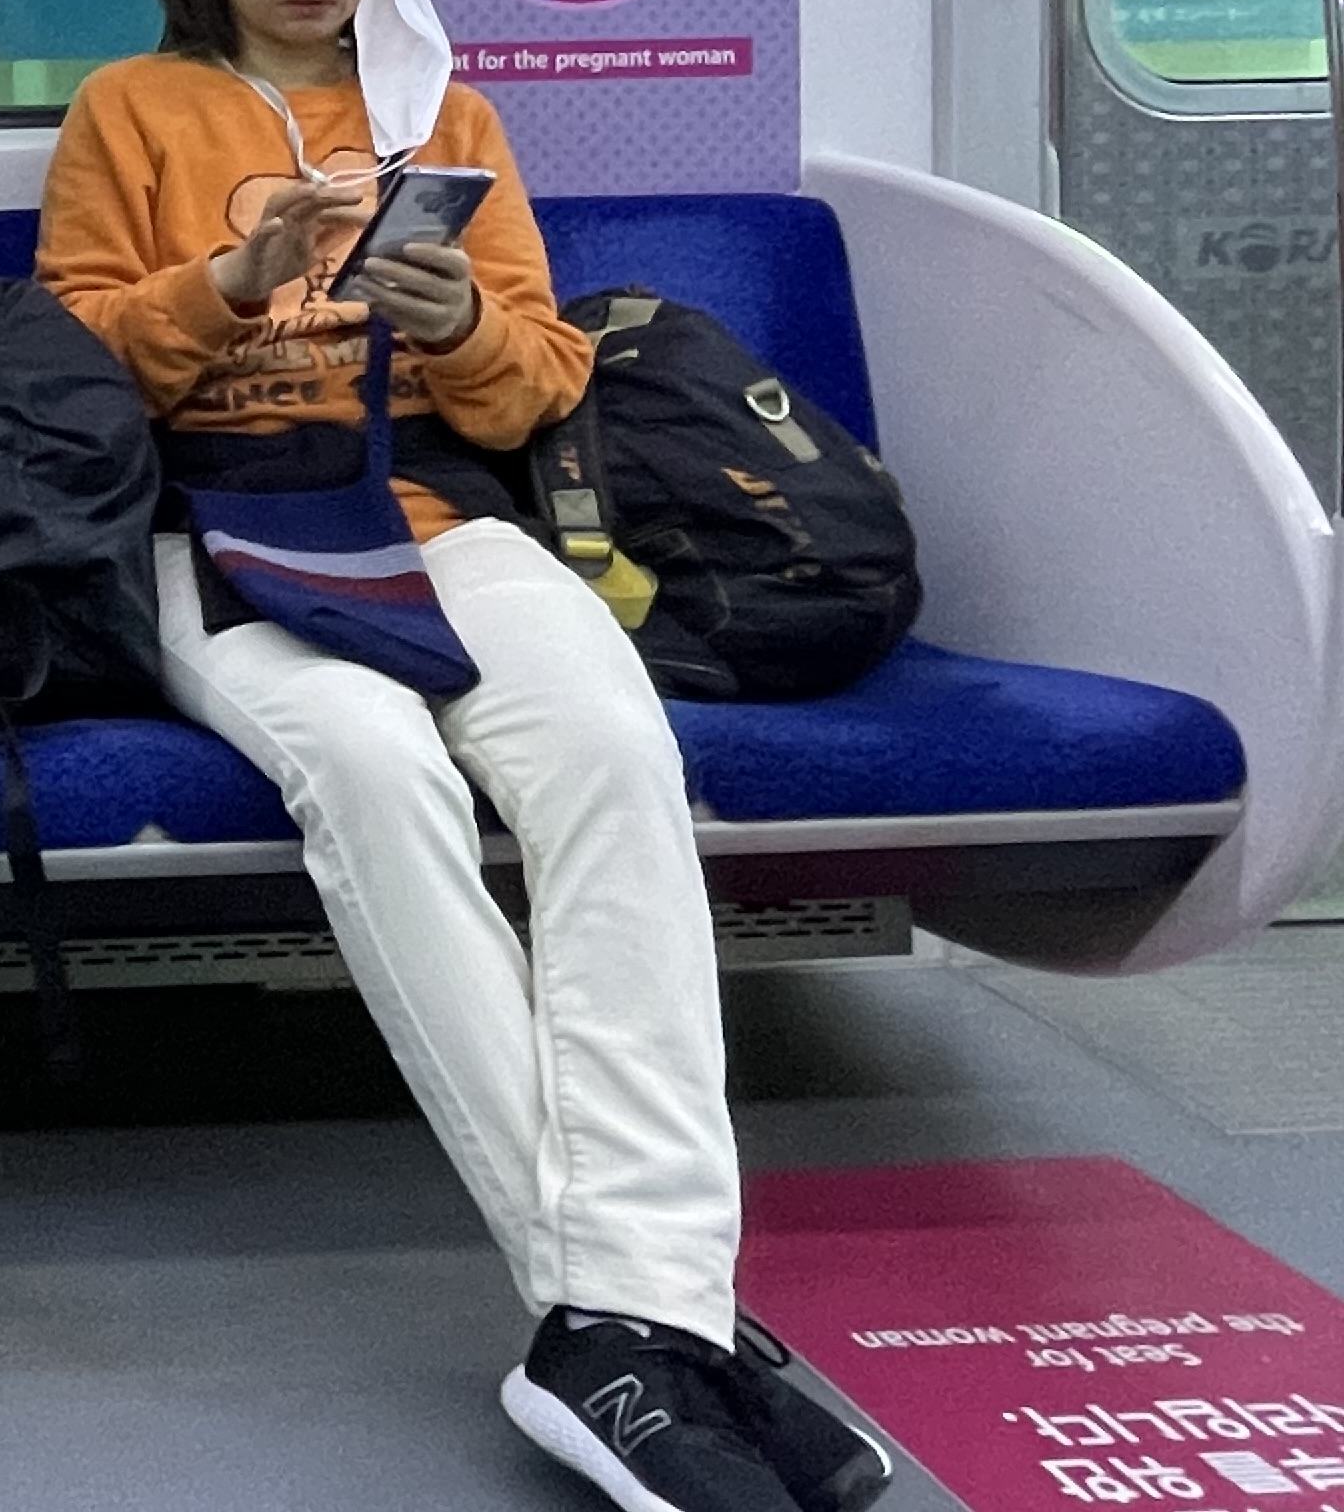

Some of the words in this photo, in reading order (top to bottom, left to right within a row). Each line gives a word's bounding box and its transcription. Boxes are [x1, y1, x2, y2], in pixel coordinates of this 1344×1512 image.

[478, 51, 509, 69] for
[514, 49, 548, 69] the
[555, 48, 652, 73] pregnant
[658, 48, 736, 67] woman
[849, 1324, 1015, 1349] woman
[1016, 1312, 1221, 1344] pregnant
[1222, 1312, 1305, 1336] the
[1024, 1346, 1096, 1372] for
[1096, 1344, 1203, 1368] Seat
[1040, 1457, 1204, 1503] 위한
[1199, 1450, 1344, 1493] 부를
